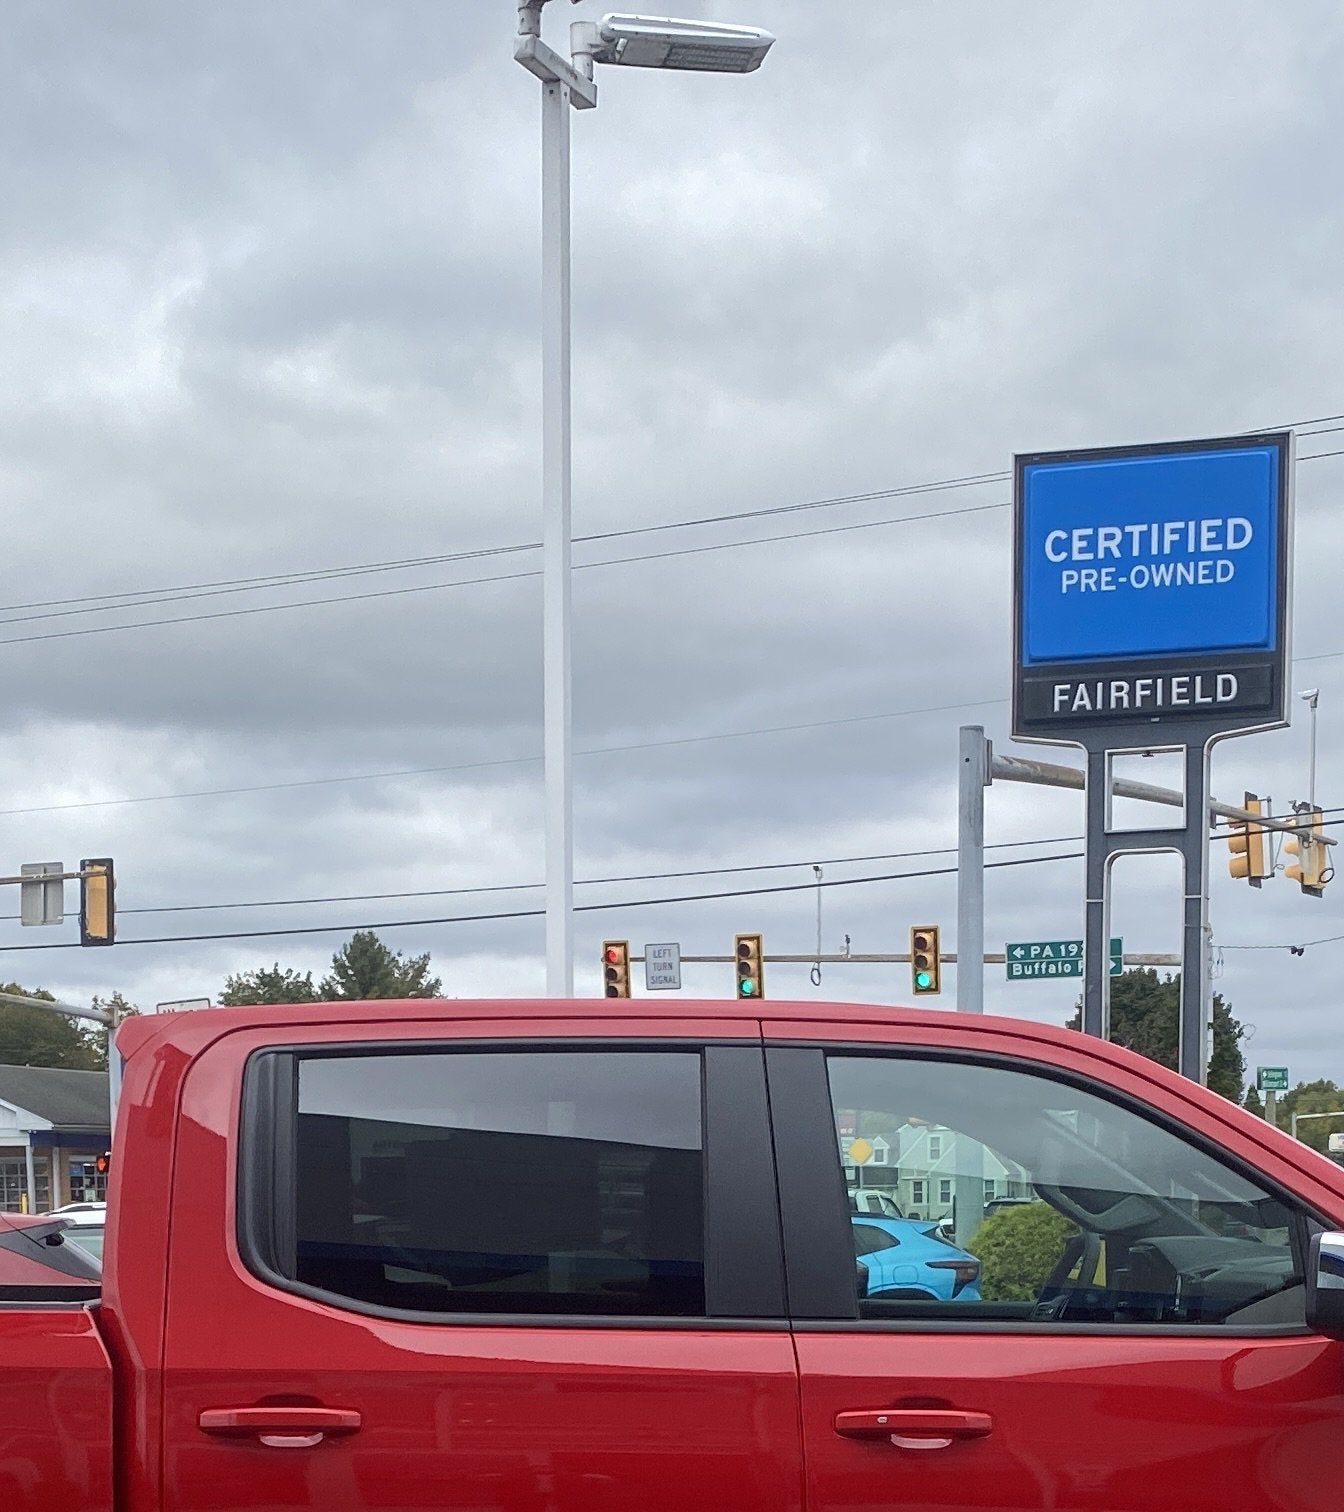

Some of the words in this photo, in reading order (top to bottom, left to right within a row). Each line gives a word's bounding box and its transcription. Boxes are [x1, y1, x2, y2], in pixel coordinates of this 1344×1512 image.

[1044, 517, 1254, 563] CERTIFIED
[1061, 559, 1235, 594] PRE-OWNED
[1053, 673, 1238, 713] FAIRFIELD
[653, 949, 672, 958] LEFT
[1030, 945, 1054, 958] PA
[1060, 943, 1084, 957] 19
[653, 962, 673, 971] TURN
[1012, 962, 1072, 976] Buffalo
[650, 975, 678, 984] SIGNAL
